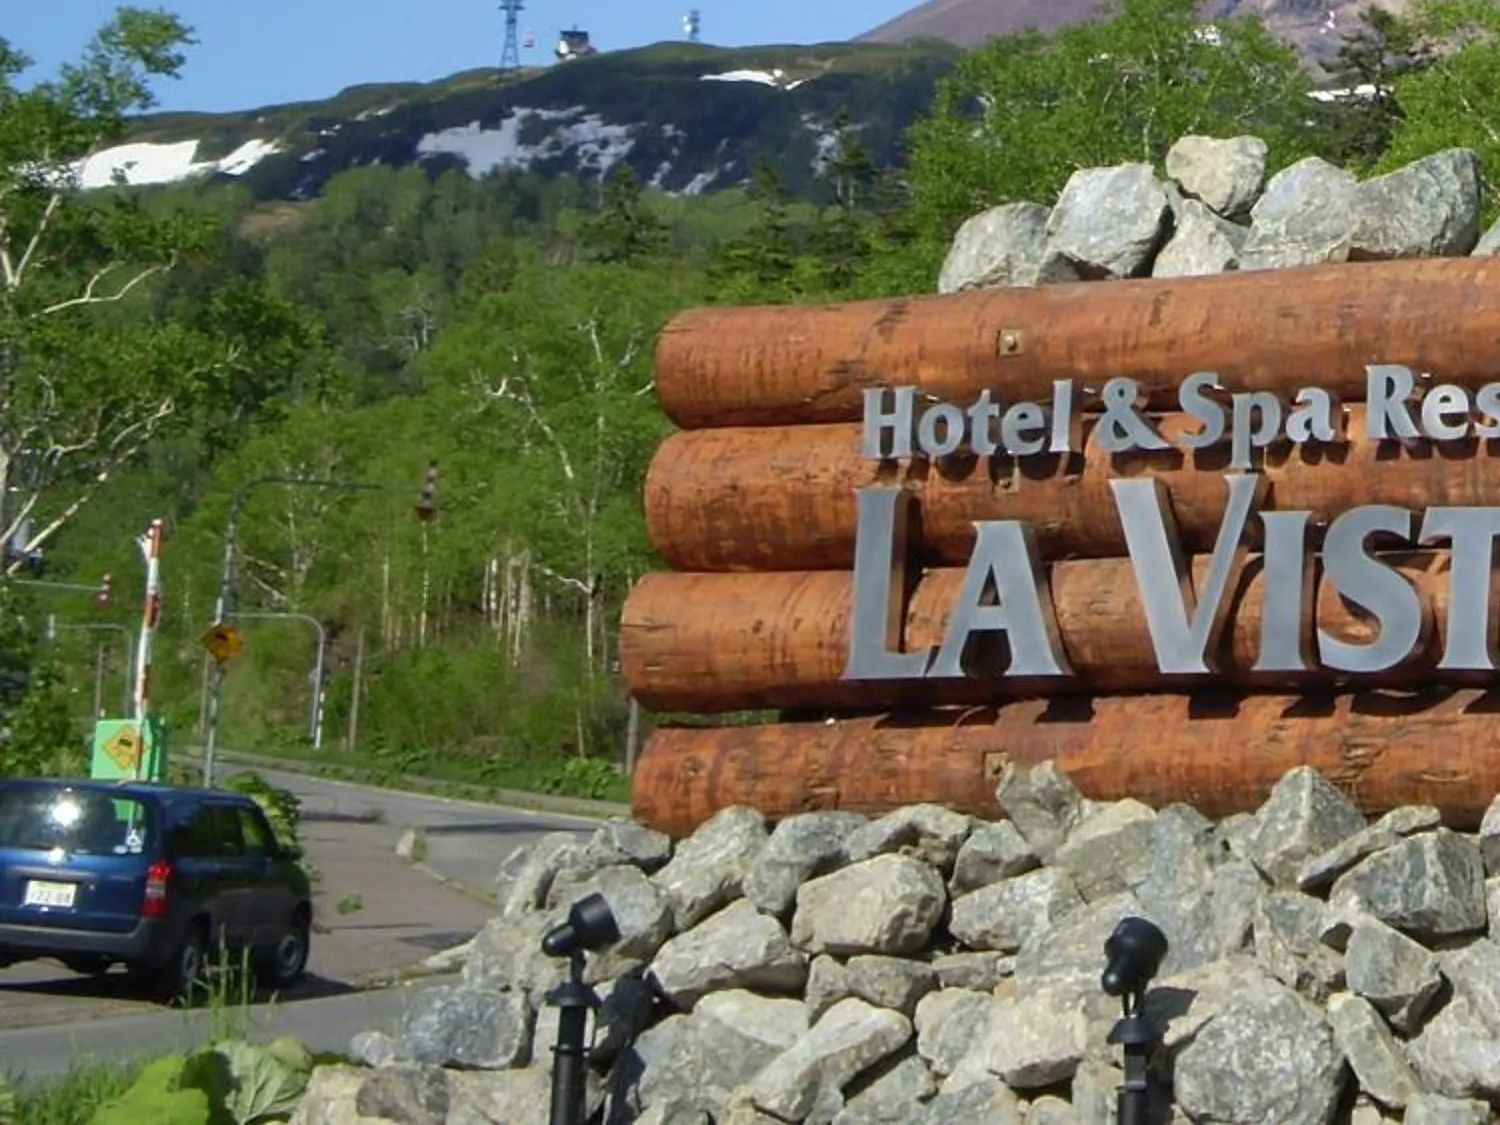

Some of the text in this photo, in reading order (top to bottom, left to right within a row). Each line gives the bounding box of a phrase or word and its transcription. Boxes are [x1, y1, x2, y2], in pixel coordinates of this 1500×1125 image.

[863, 380, 1073, 459] Hotel
[1095, 377, 1179, 452] &
[1177, 372, 1332, 468] Spa
[843, 485, 1071, 678] LA
